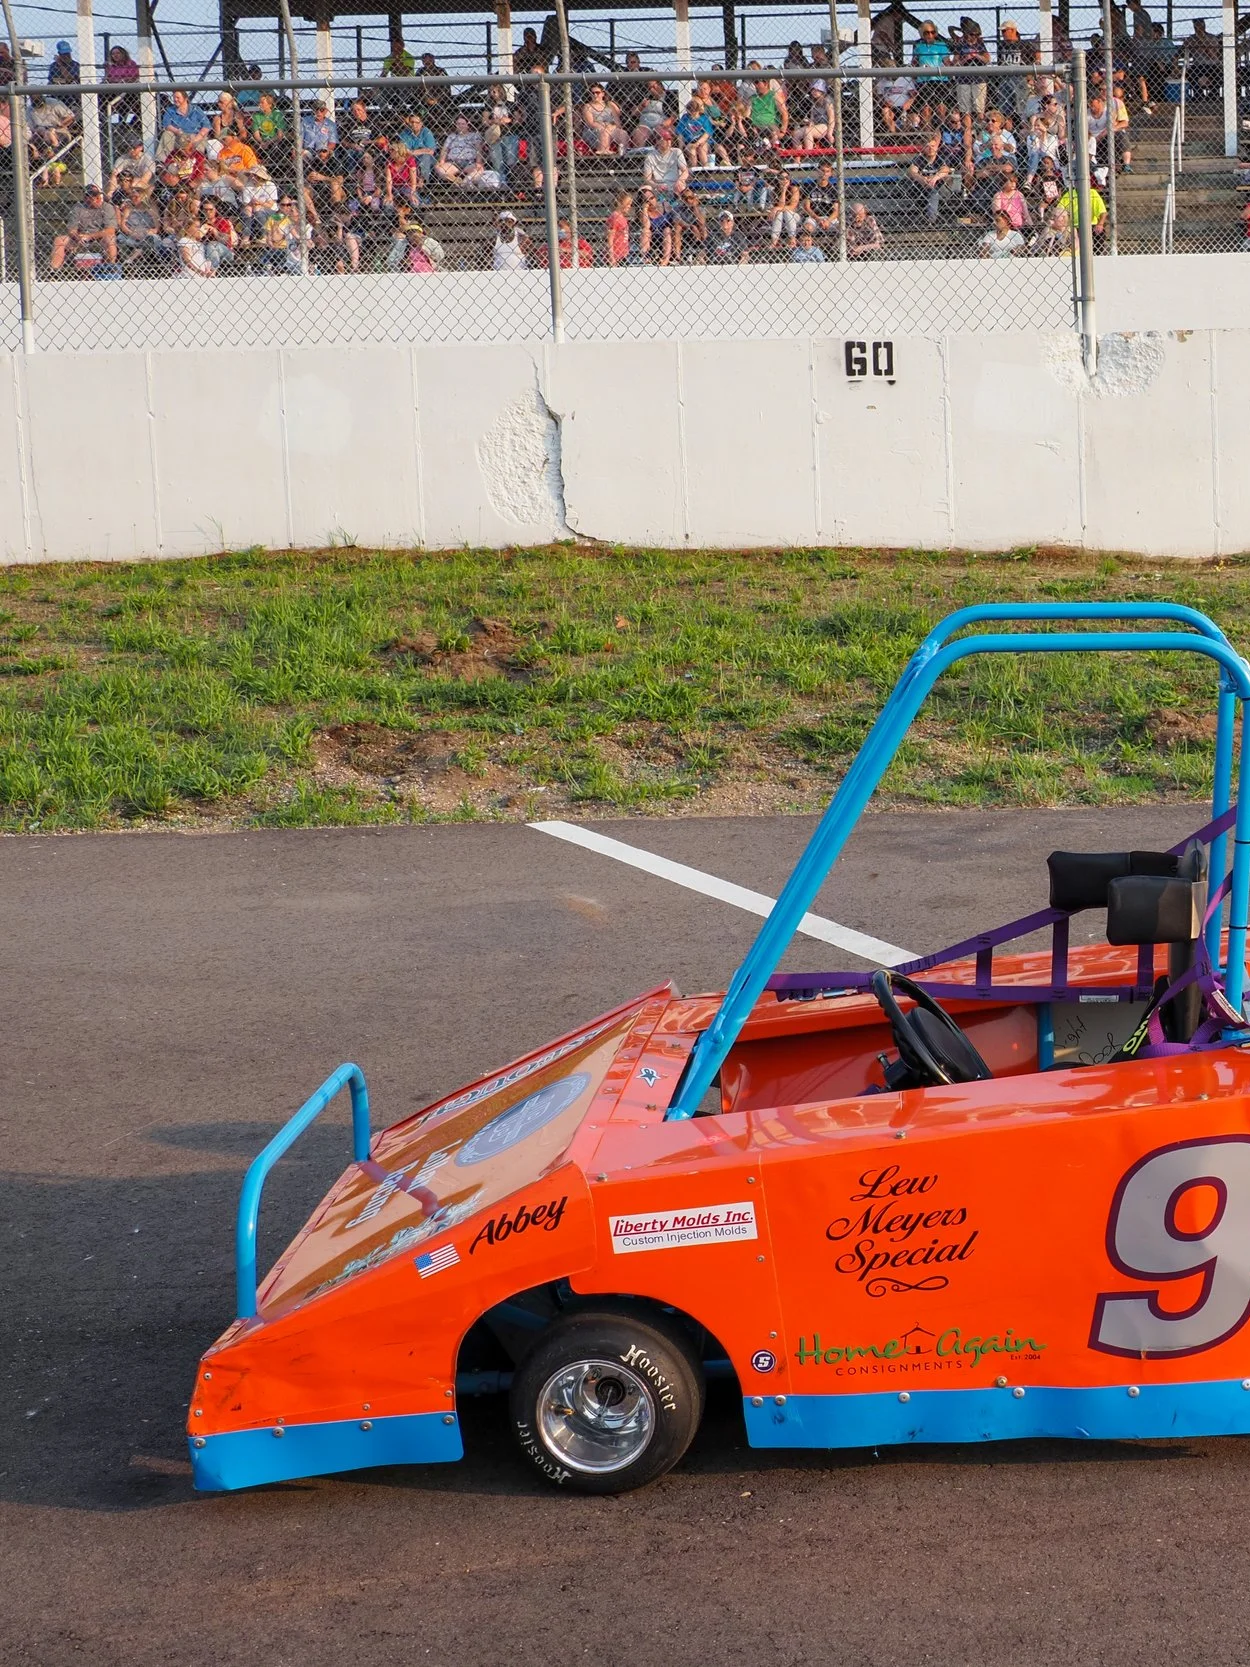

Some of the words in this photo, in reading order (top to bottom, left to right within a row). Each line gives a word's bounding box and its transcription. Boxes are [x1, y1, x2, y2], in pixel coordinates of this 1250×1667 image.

[345, 1160, 420, 1229] Racing
[849, 1165, 938, 1202] Lew
[469, 1195, 568, 1255] Abbey
[613, 1218, 668, 1237] Liberty
[672, 1212, 720, 1228] Molds
[723, 1210, 754, 1223] Inc.
[622, 1236, 664, 1247] Custom
[666, 1230, 712, 1243] Injection
[714, 1226, 748, 1237] Molds
[825, 1200, 967, 1243] Meyers
[834, 1230, 979, 1281] Special
[795, 1332, 910, 1364] Home
[935, 1327, 1047, 1368] Again
[835, 1360, 963, 1377] CONSIGNMENTS
[619, 1344, 677, 1411] Hoosier
[516, 1421, 573, 1484] Hoosier
